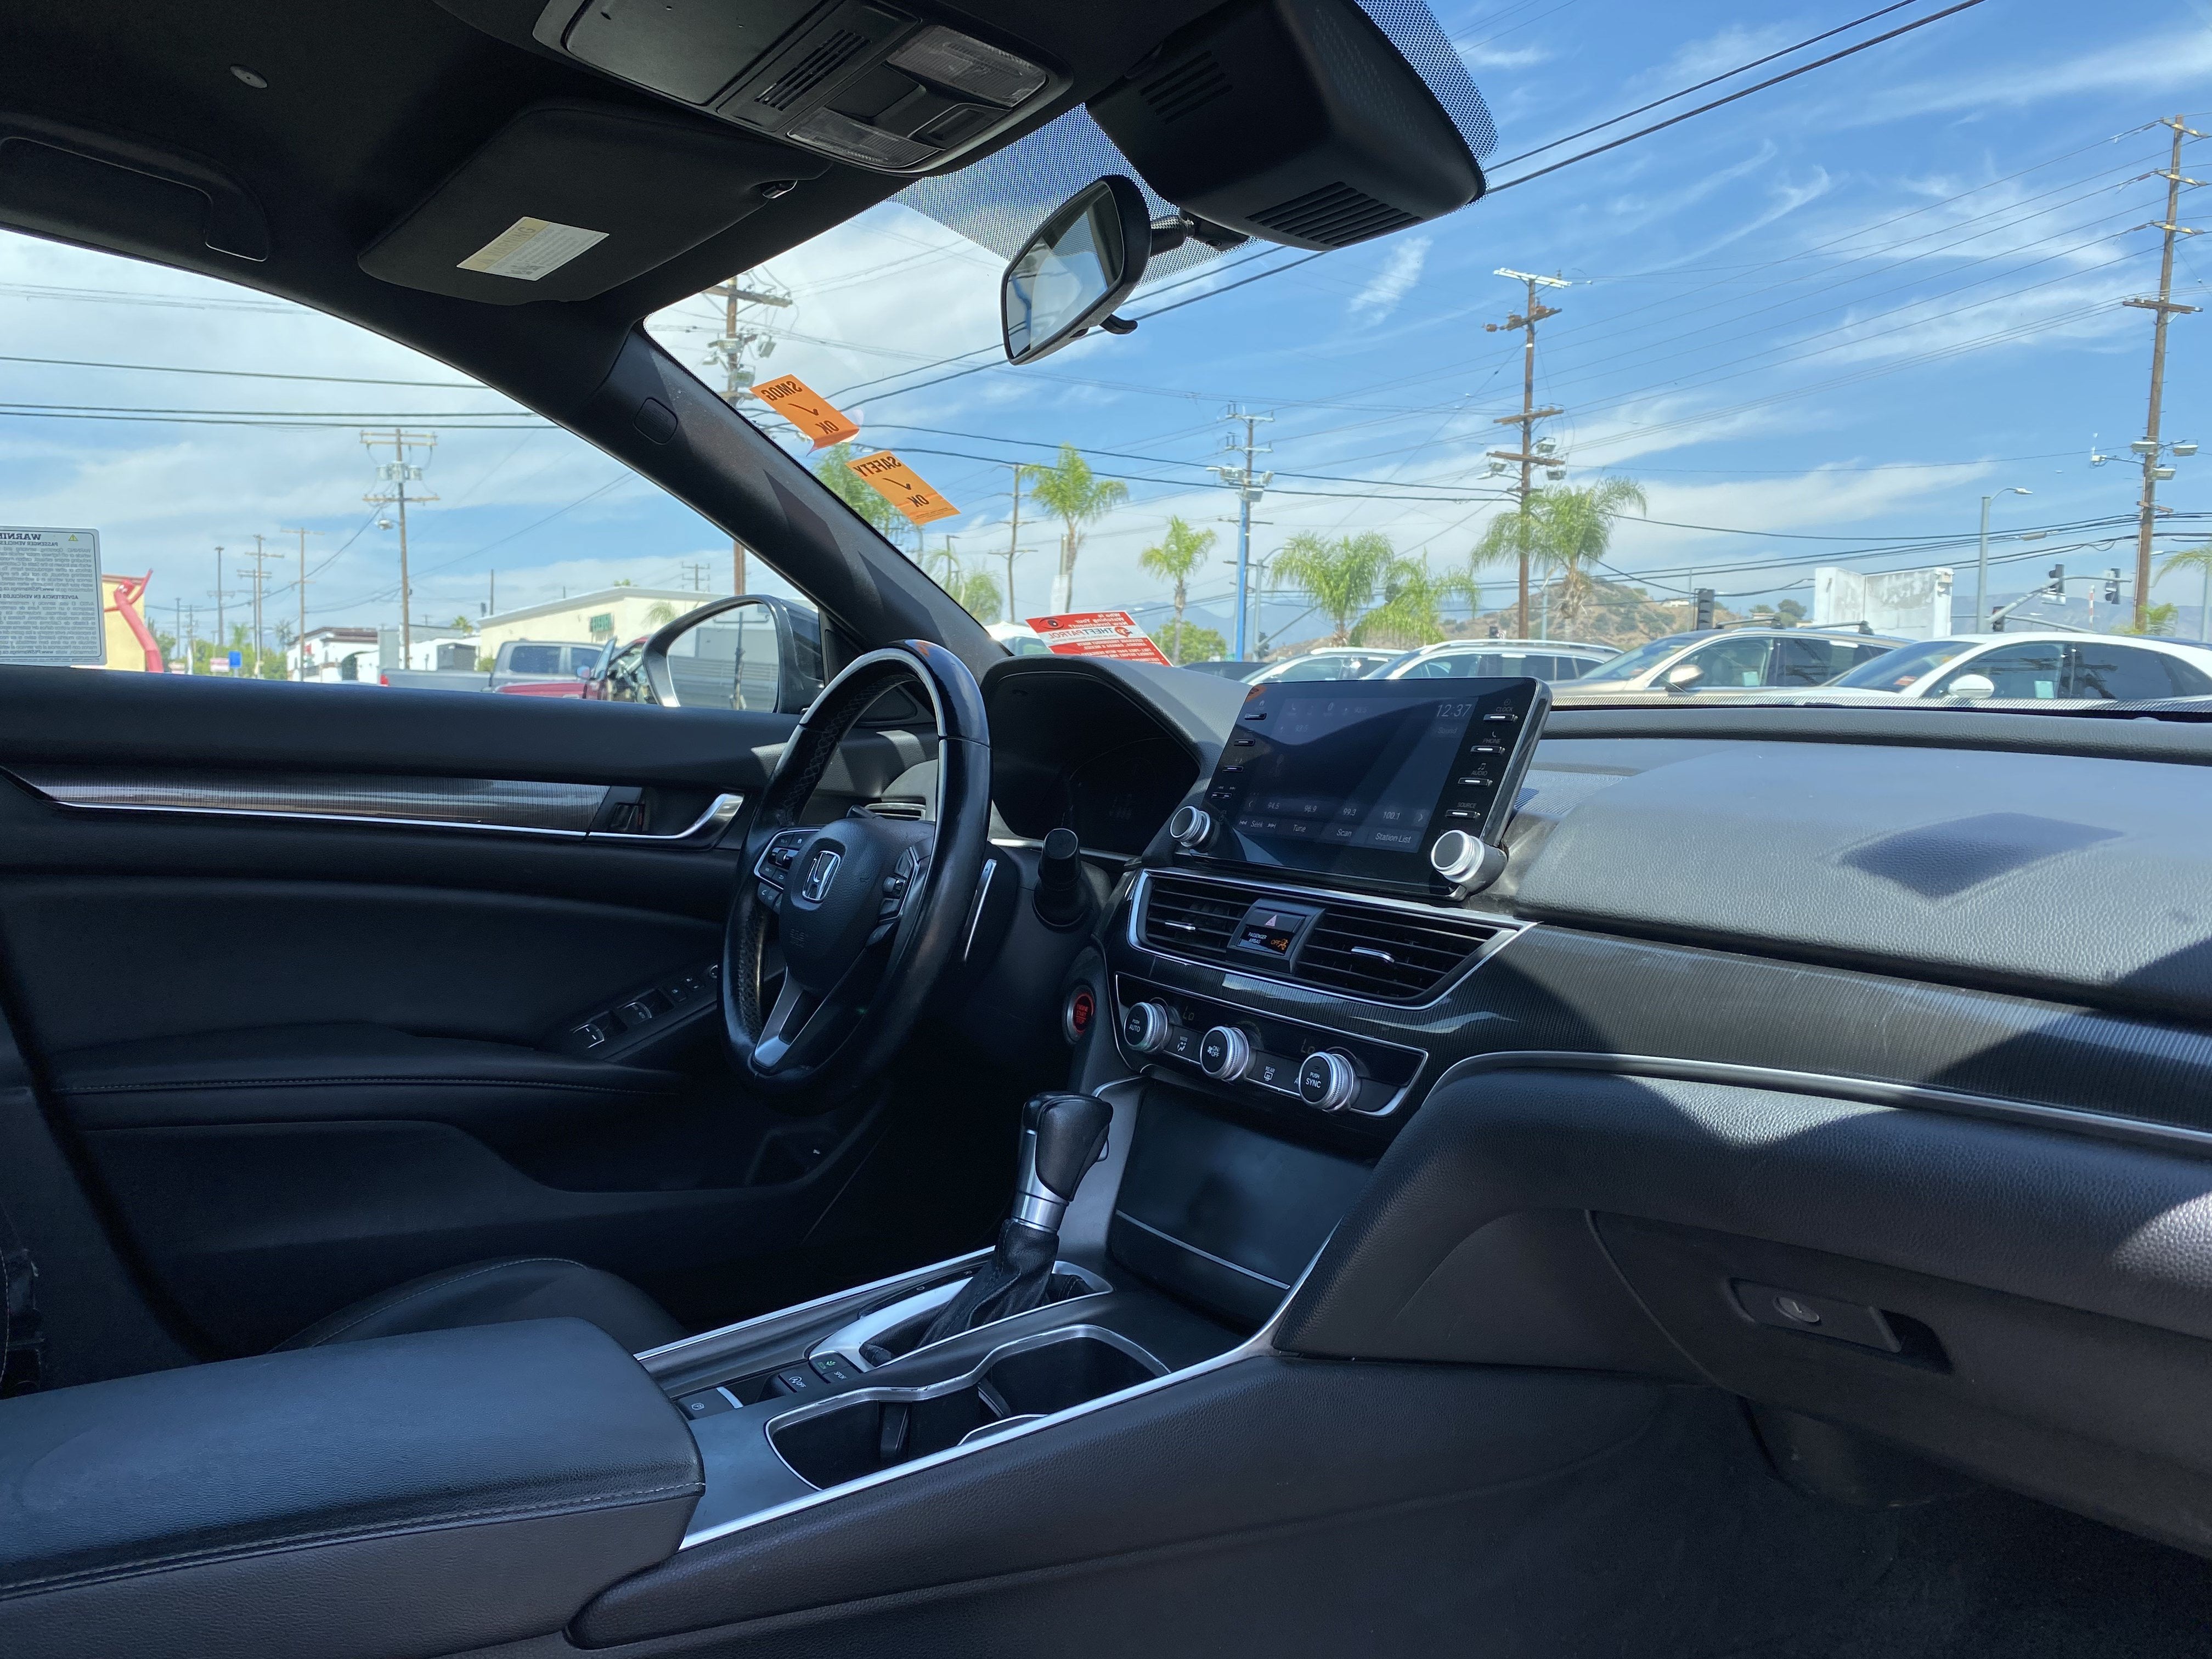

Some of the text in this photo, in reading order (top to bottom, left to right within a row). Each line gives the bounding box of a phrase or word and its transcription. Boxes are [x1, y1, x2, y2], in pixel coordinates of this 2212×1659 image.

[1437, 704, 1472, 718] 12:37
[1343, 808, 1357, 816] 99.3
[1383, 811, 1401, 820] 100.1
[1336, 828, 1352, 837] Scan
[1375, 832, 1398, 842] Station
[1398, 834, 1412, 843] List
[1128, 1024, 1141, 1032] AUTO
[1305, 1077, 1321, 1088] SYNC
